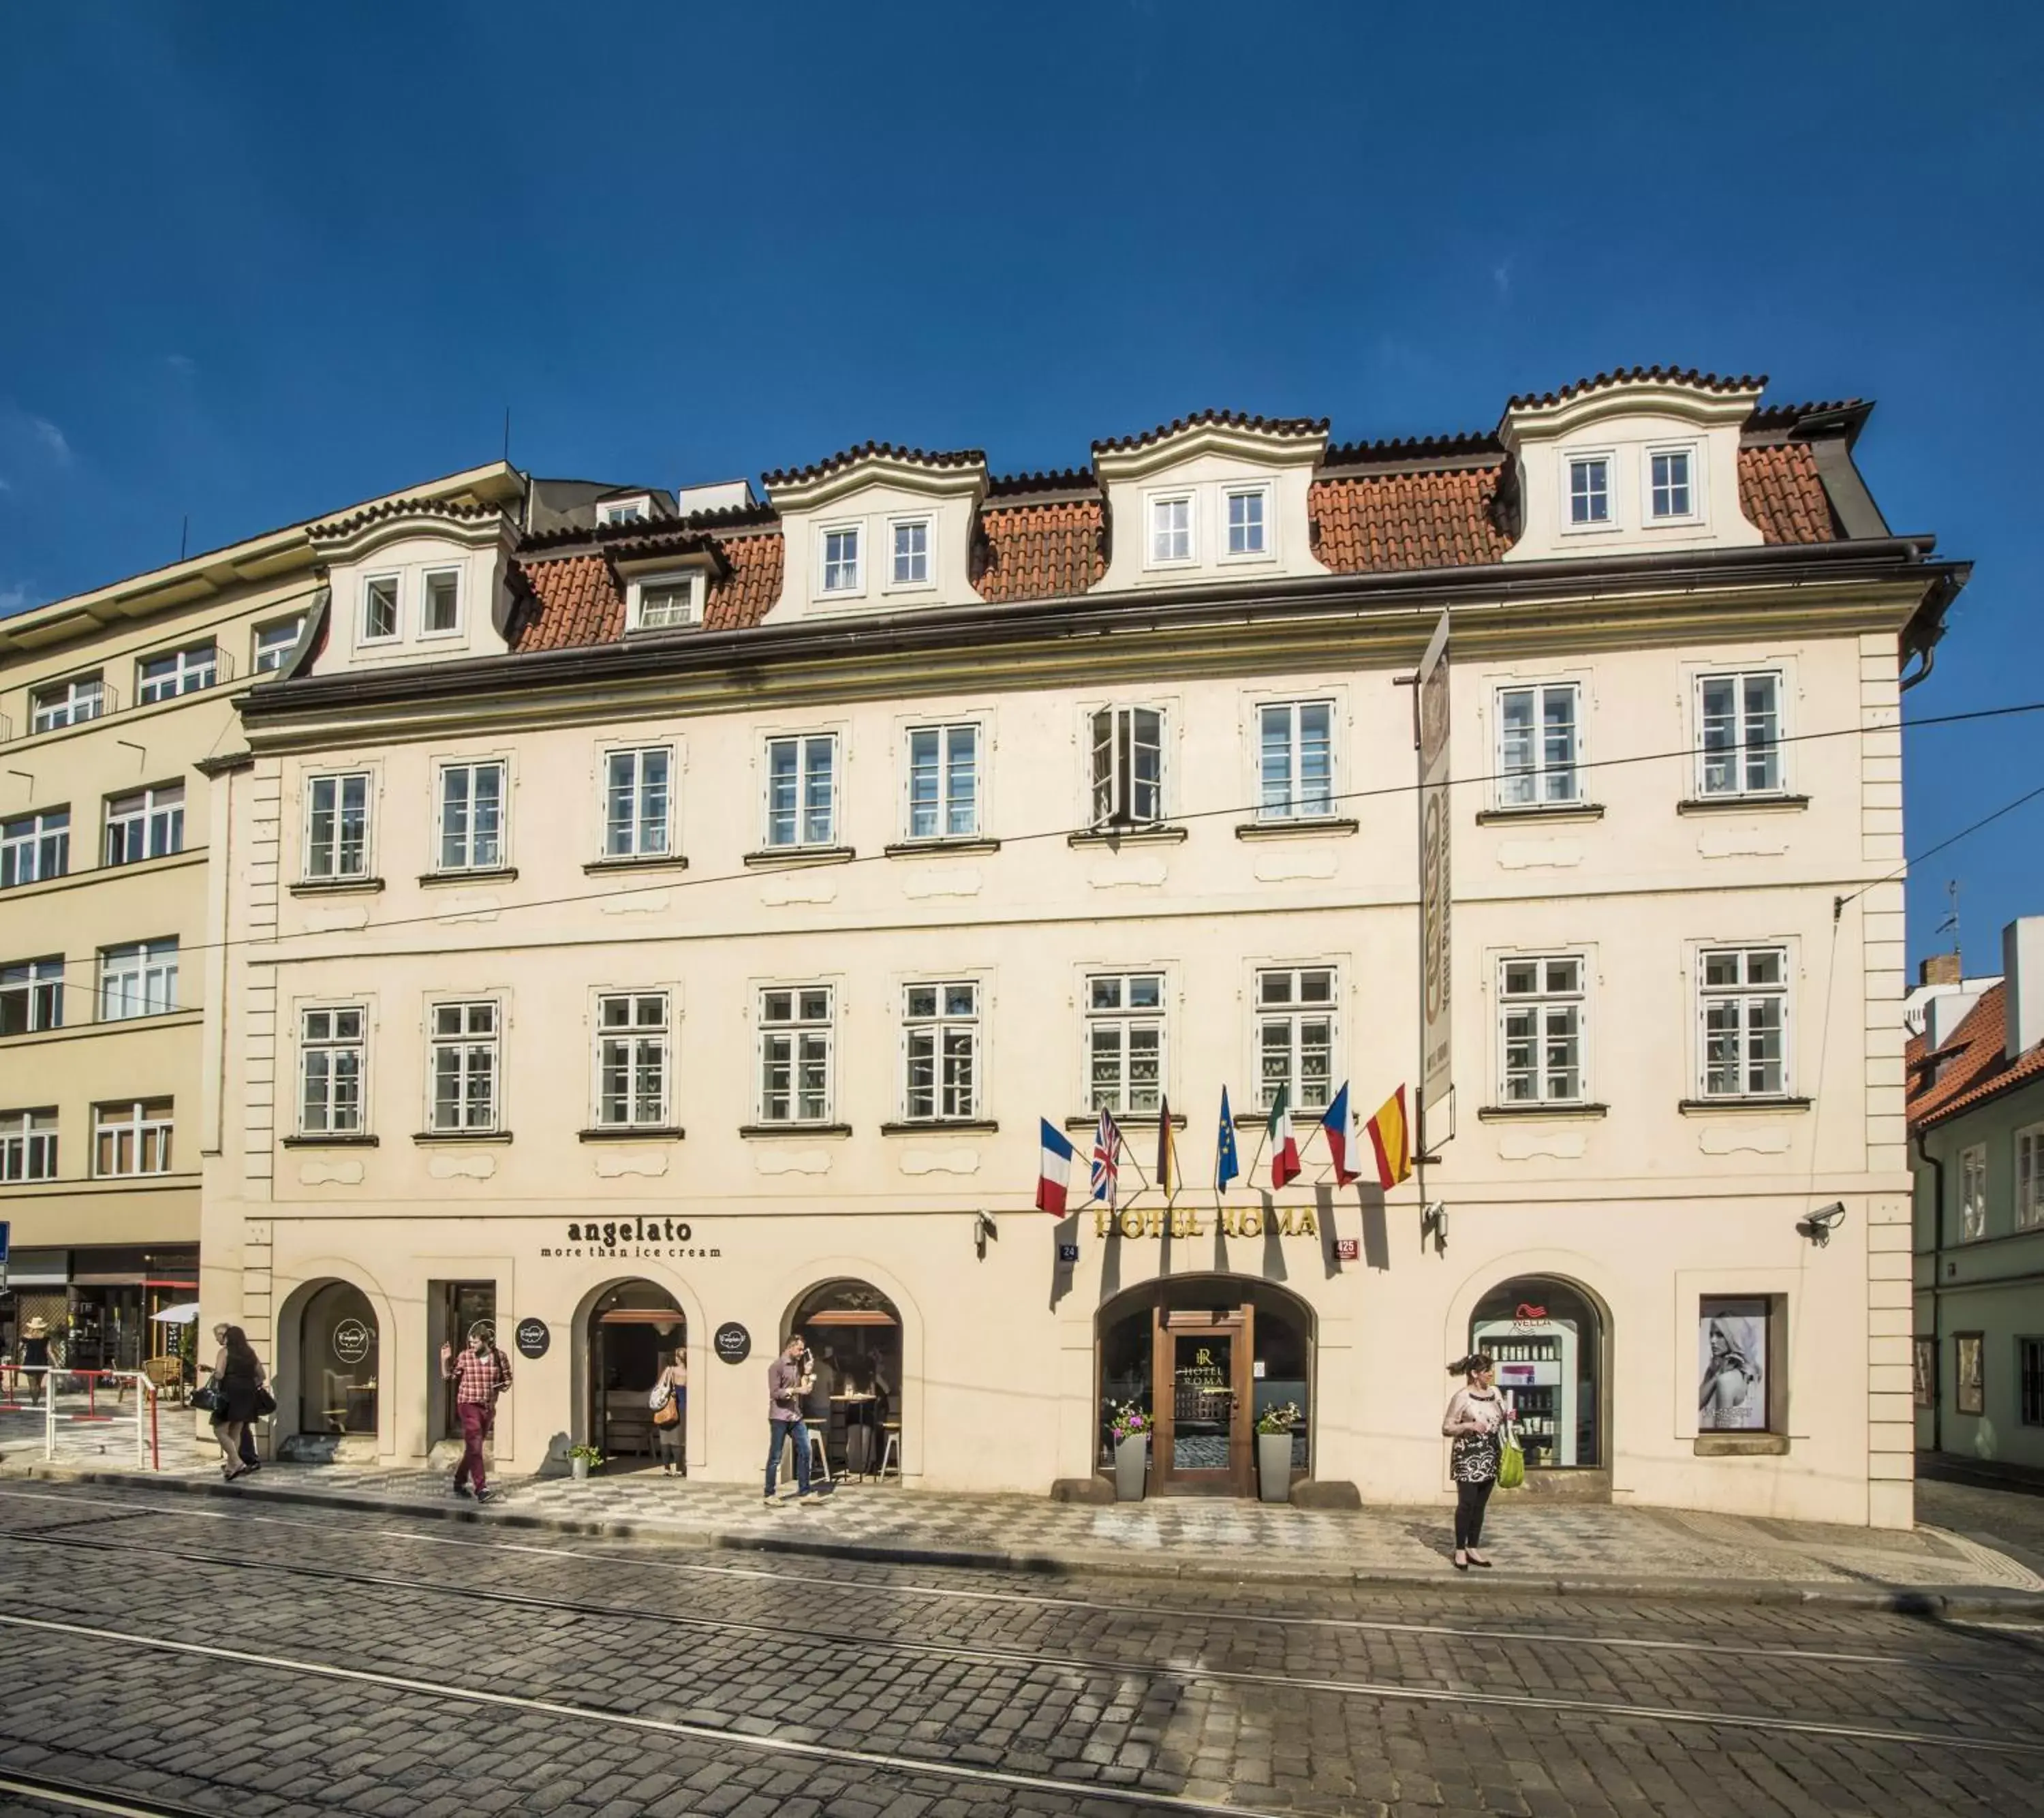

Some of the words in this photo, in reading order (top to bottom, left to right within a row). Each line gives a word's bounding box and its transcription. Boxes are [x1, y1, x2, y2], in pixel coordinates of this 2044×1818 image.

[568, 1216, 692, 1248] angelato
[541, 1248, 581, 1257] more
[590, 1246, 627, 1257] than
[636, 1246, 660, 1257] ice
[668, 1249, 721, 1257] cream
[1064, 1247, 1074, 1256] 24
[1337, 1241, 1354, 1252] 425
[1185, 1367, 1223, 1375] HOTEL
[1184, 1377, 1224, 1385] ROMA
